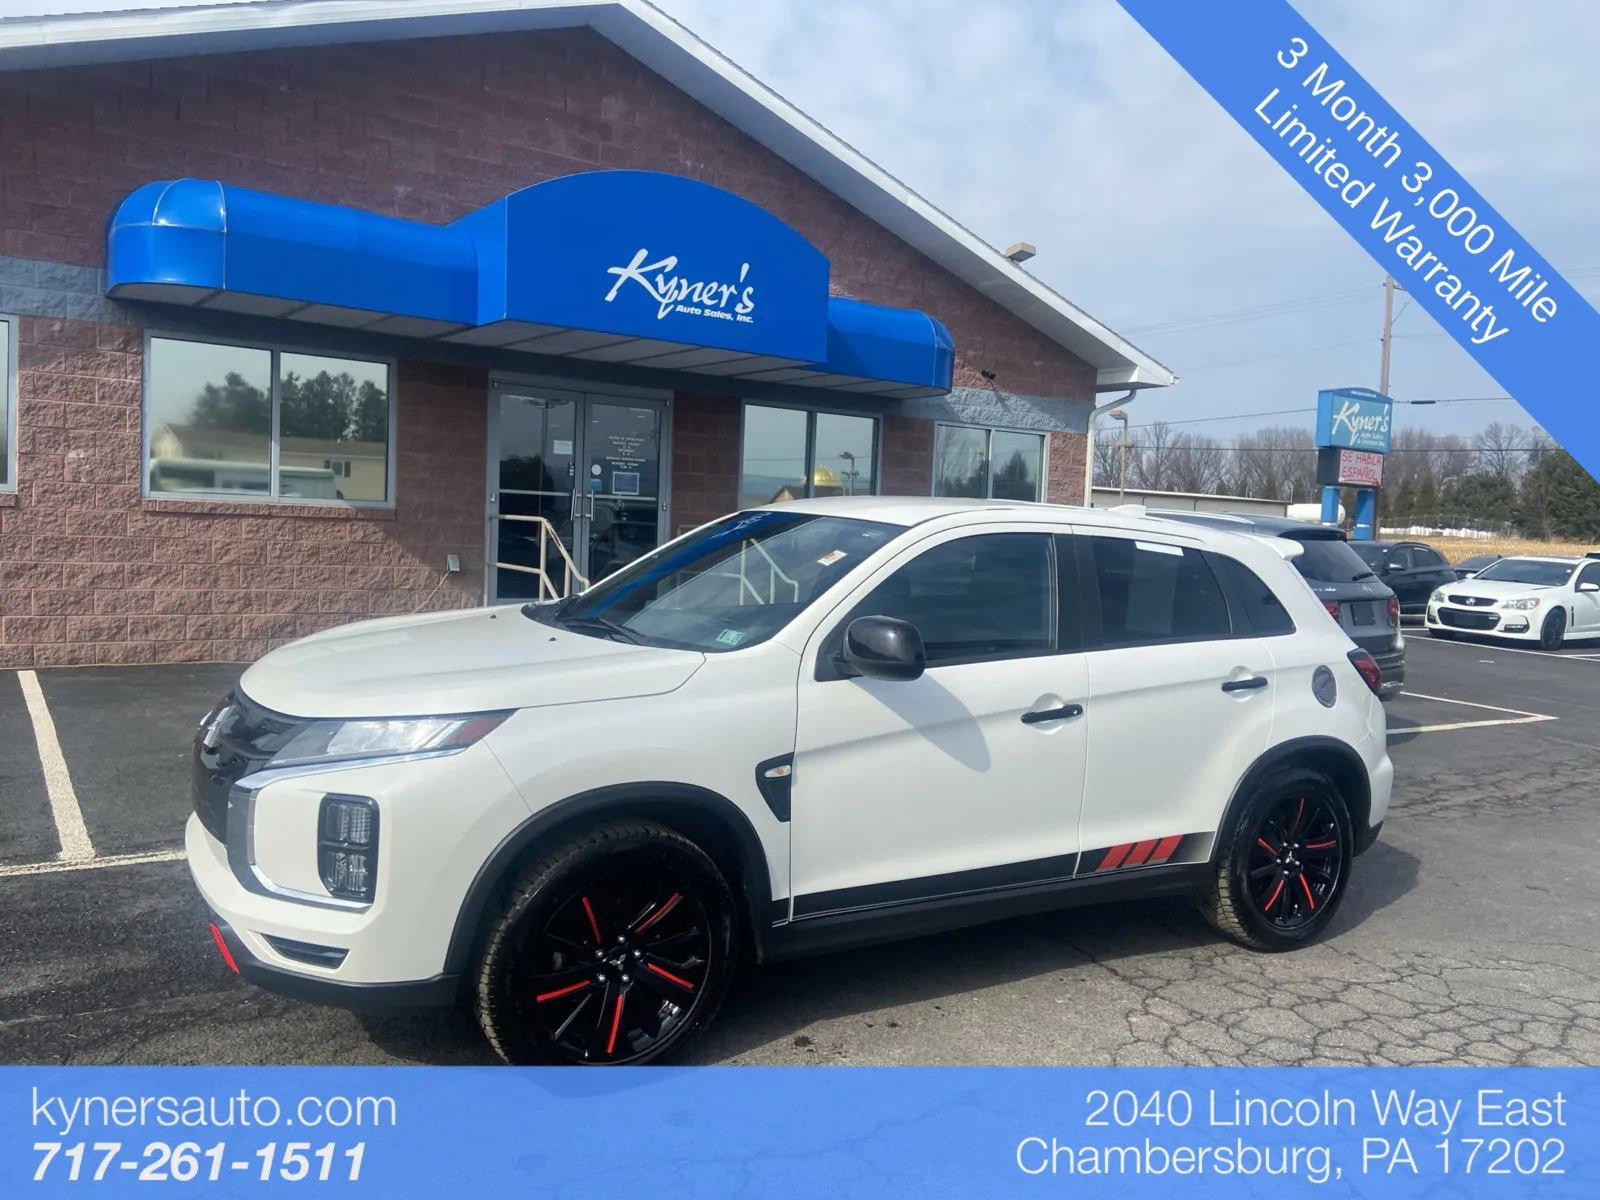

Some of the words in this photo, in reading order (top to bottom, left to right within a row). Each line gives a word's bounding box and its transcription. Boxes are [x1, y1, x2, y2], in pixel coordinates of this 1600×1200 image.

[605, 248, 755, 320] Kyner's
[675, 304, 702, 316] Auto
[703, 308, 734, 321] Sales,
[736, 314, 754, 324] Inc.
[1332, 401, 1388, 446] Kyner's
[1356, 453, 1381, 466] HABLA
[1342, 466, 1377, 480] ESPAÑOL
